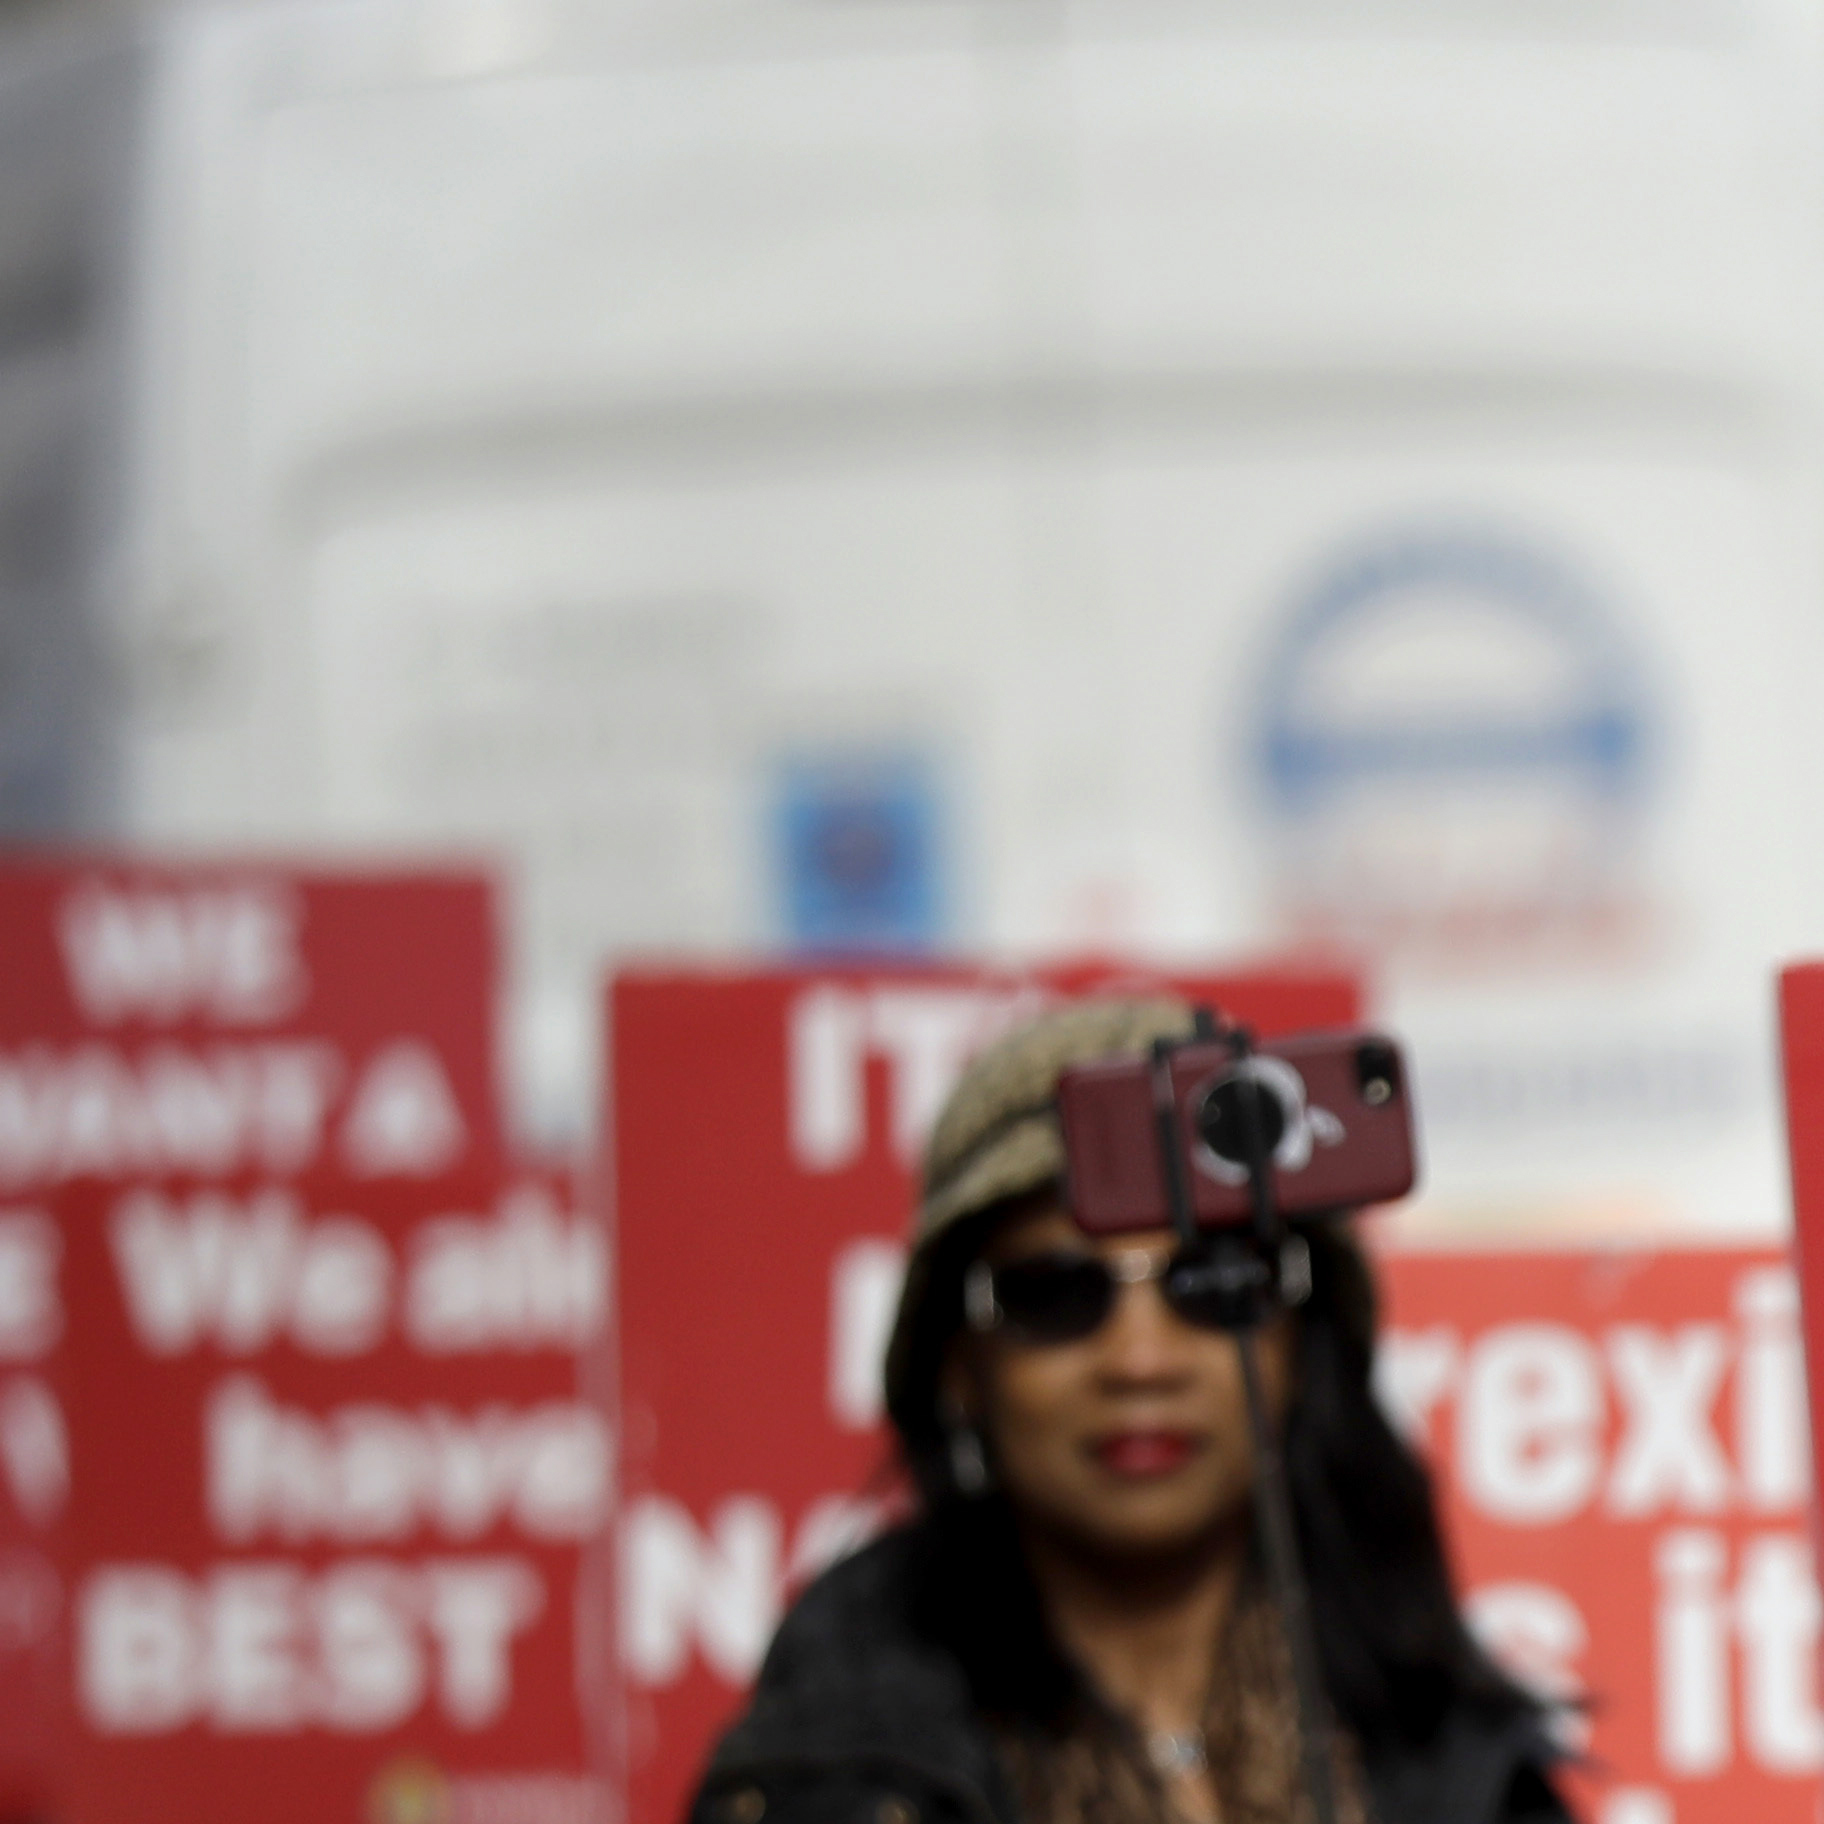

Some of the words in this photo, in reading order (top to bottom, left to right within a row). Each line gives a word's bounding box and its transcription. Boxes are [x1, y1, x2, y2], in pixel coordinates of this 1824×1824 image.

[62, 882, 304, 1020] WE
[345, 1047, 462, 1172] A
[115, 1190, 392, 1350] We
[80, 1560, 538, 1728] BEST
